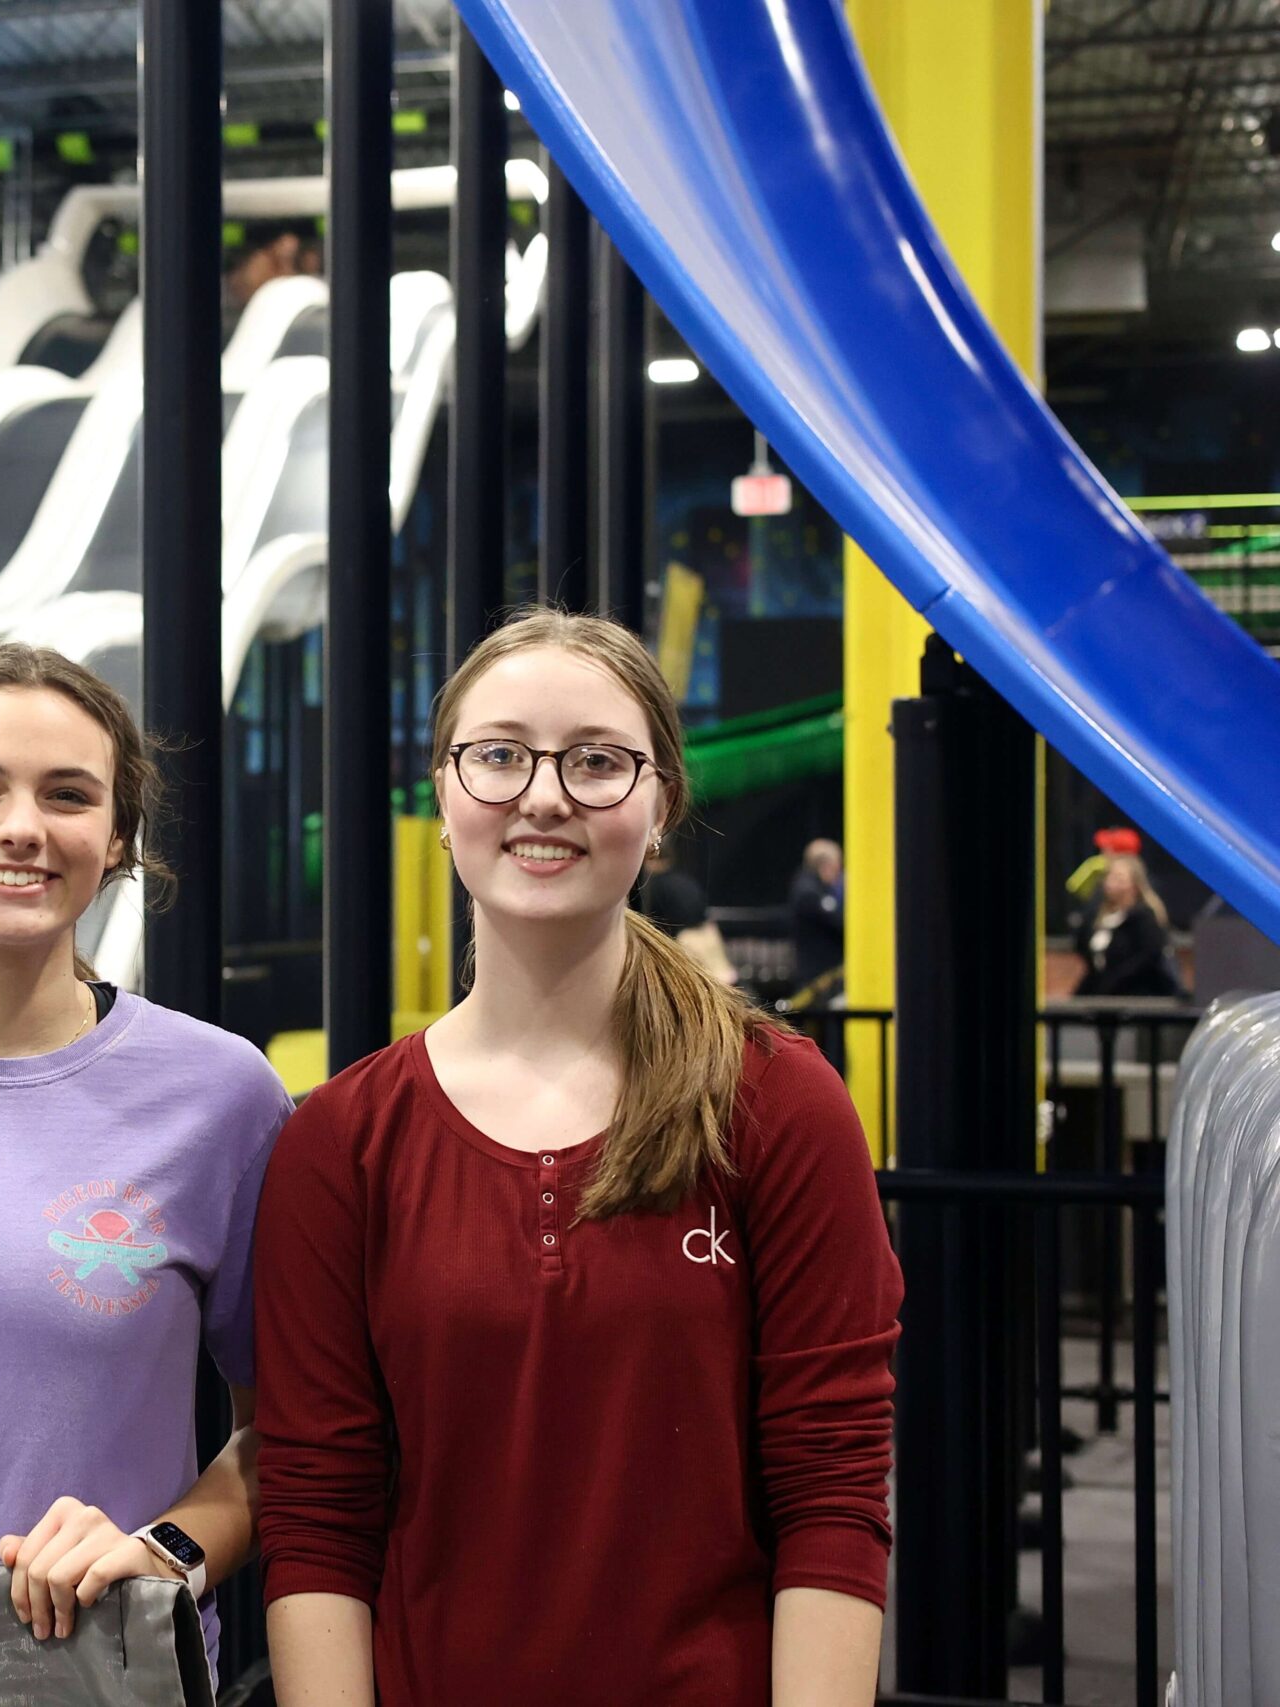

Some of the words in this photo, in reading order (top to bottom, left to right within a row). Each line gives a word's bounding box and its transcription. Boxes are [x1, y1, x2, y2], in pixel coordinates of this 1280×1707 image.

[42, 1179, 117, 1224] PIGEON
[122, 1183, 166, 1235] RIVER
[47, 1264, 160, 1316] TENNESSEE
